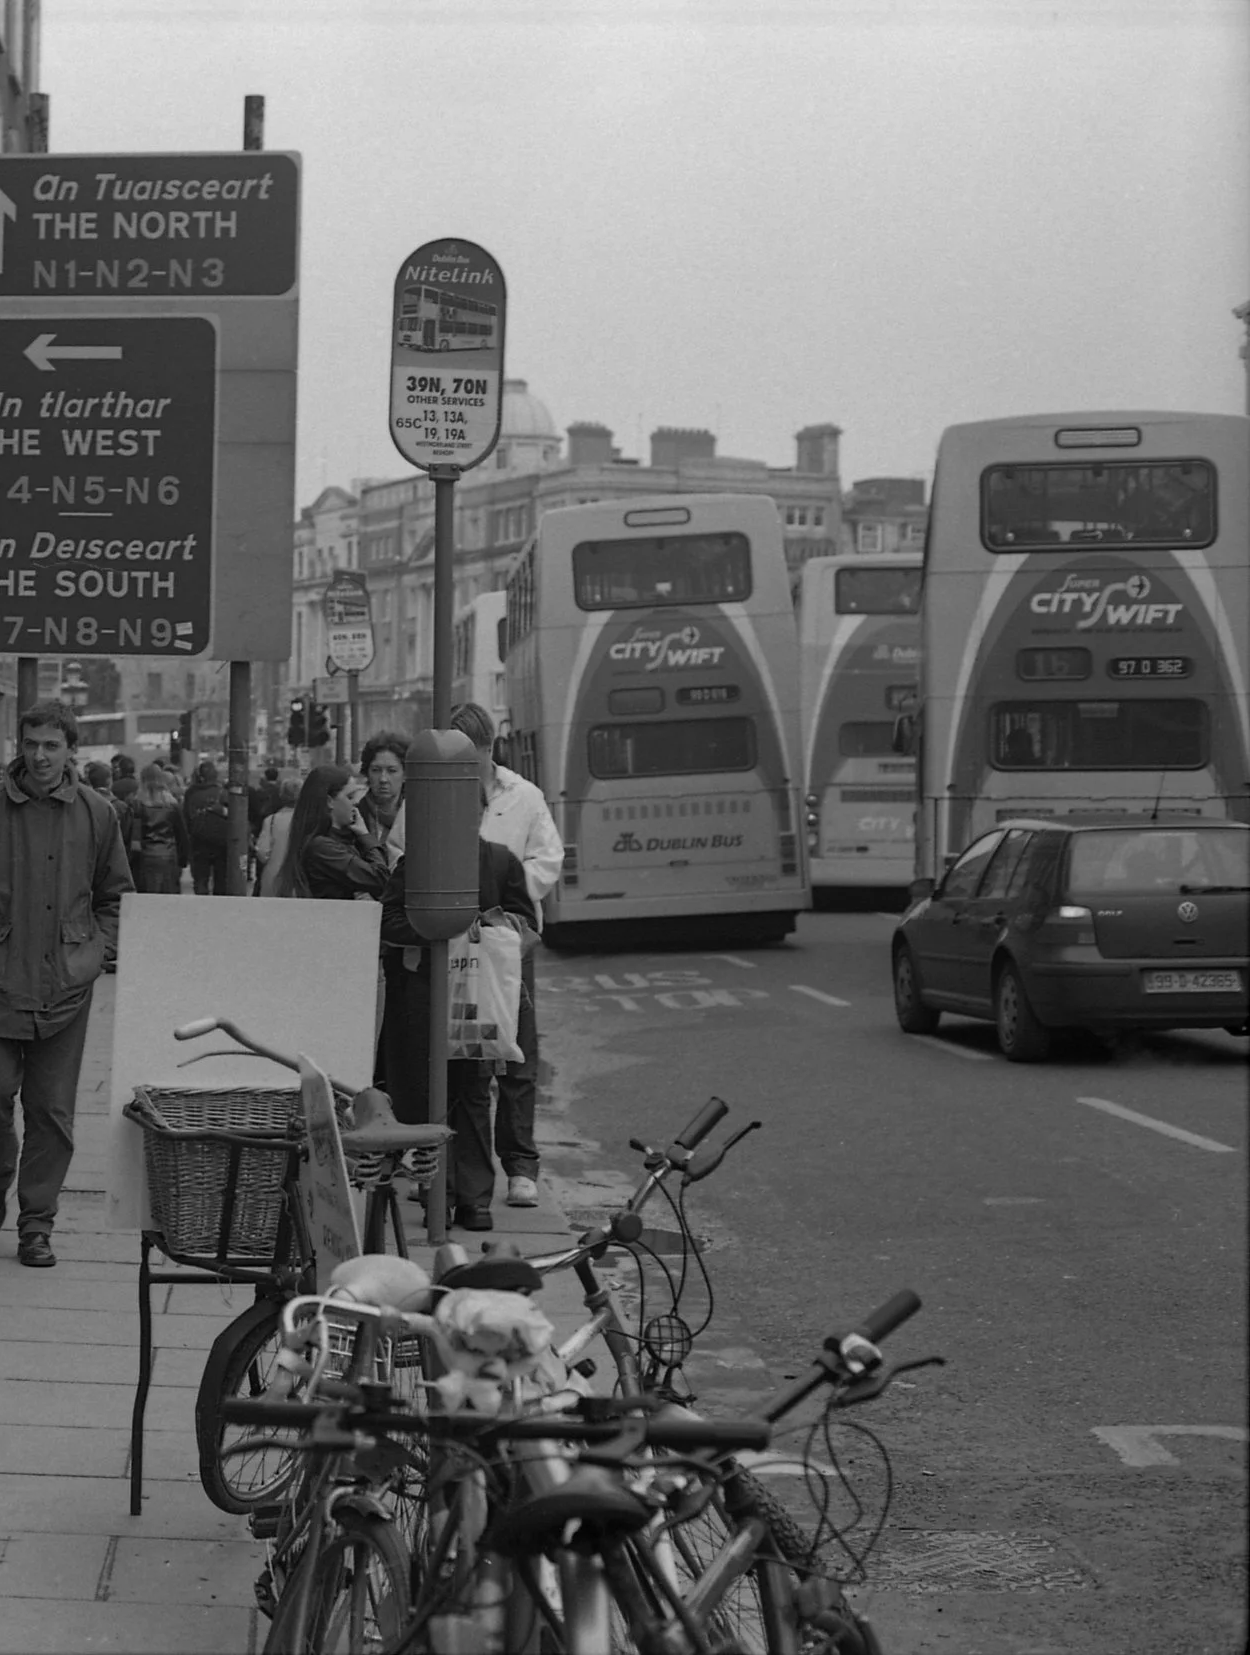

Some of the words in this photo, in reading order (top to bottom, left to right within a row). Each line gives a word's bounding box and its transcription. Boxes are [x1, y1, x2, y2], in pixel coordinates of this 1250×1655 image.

[33, 173, 79, 201] An
[95, 172, 274, 201] Tuaisceart
[32, 212, 99, 240] THE
[113, 210, 238, 240] NORTH
[405, 265, 495, 285] Nitelink
[406, 376, 446, 396] 39N,
[453, 378, 487, 395] 70N
[407, 395, 439, 405] OTHER
[441, 397, 485, 407] SERVICES
[396, 418, 422, 429] 65C
[423, 409, 439, 424] 13,
[61, 429, 162, 456] WEST
[445, 428, 466, 441] 19A
[29, 531, 198, 561] Deisceart
[54, 570, 175, 598] SOUTH
[1030, 591, 1100, 615] CITY
[1075, 580, 1184, 631] SWIFT
[610, 641, 662, 660] CITY
[644, 631, 726, 671] SWIFT
[1118, 661, 1137, 674] 97
[646, 837, 709, 851] DUBLIN
[711, 834, 745, 849] BUS
[535, 969, 714, 993] BUS
